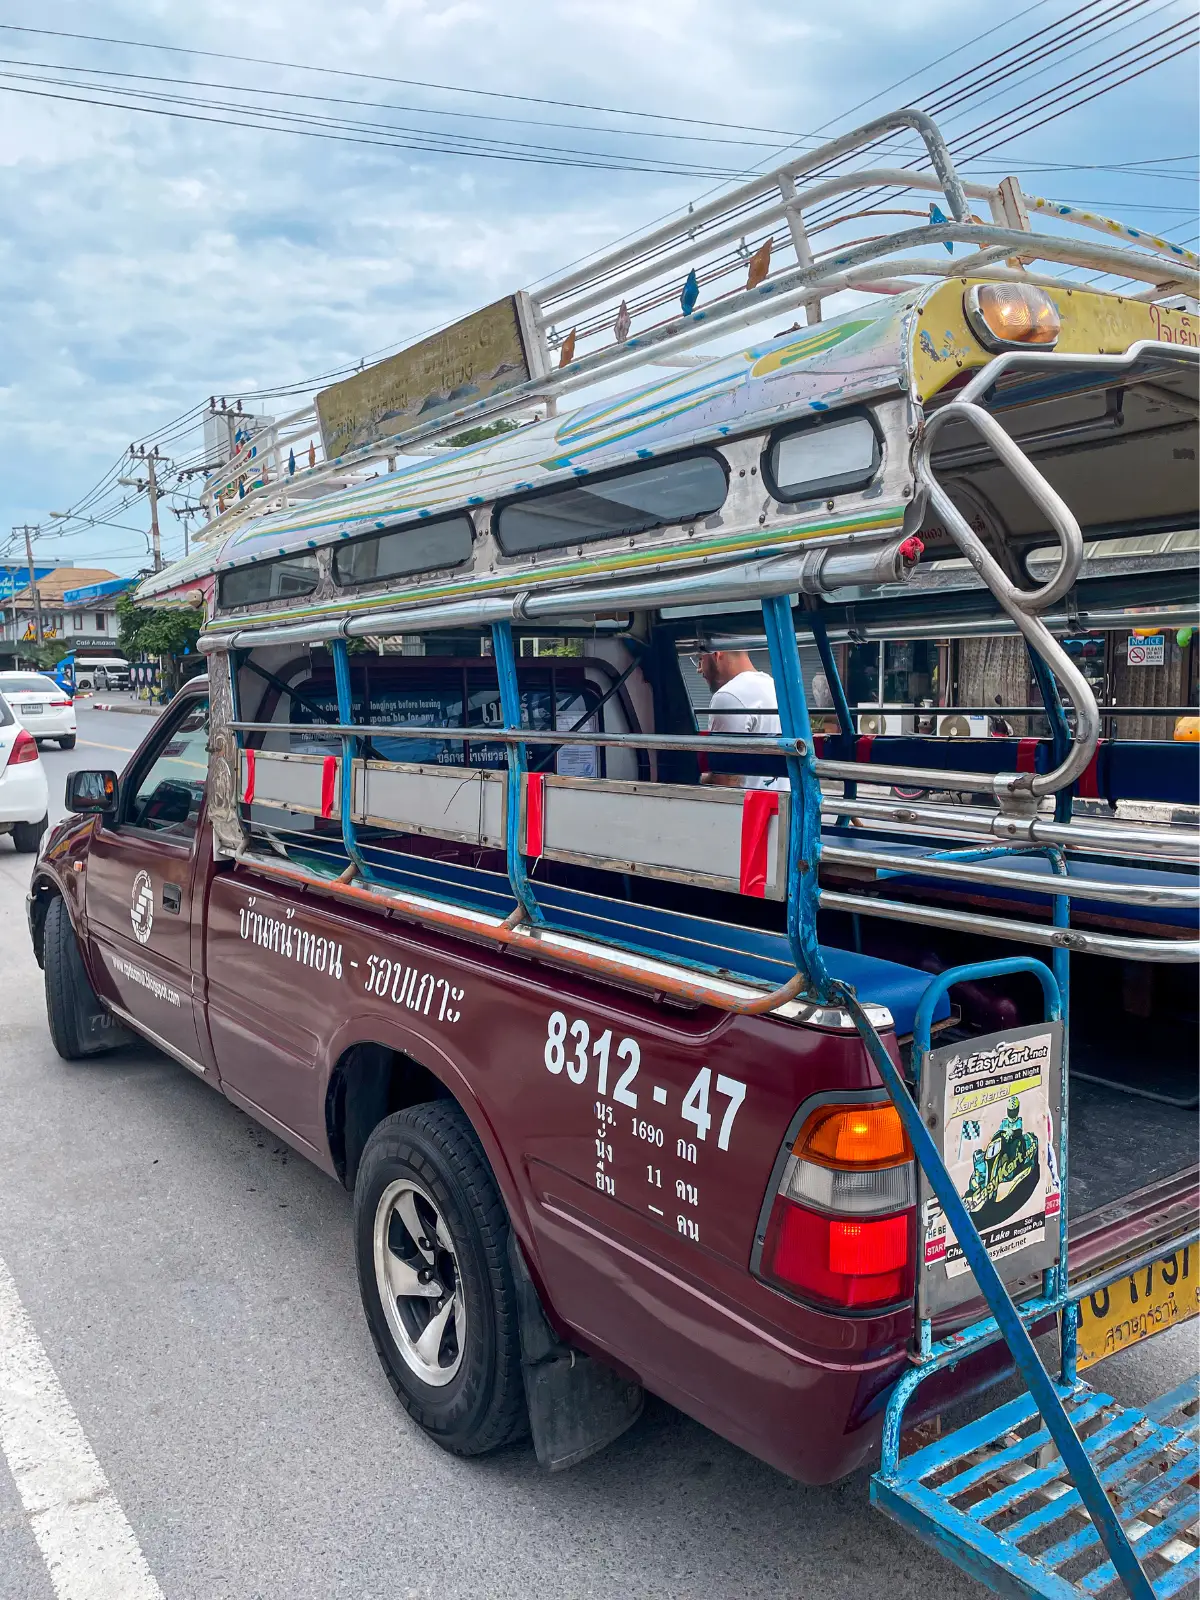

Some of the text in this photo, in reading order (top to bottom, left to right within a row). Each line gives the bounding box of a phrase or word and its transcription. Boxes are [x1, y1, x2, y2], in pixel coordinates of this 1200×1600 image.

[398, 700, 418, 709] before
[419, 699, 441, 710] leaving
[407, 712, 419, 721] for
[421, 713, 434, 722] any
[350, 960, 359, 968] -
[365, 954, 465, 1023] รอบเกาะ
[967, 1045, 1048, 1074] EasyKart.net
[544, 1011, 747, 1151] 8312 - 47
[955, 1083, 974, 1094] Open
[976, 1080, 984, 1088] 10
[1022, 1067, 1040, 1077] Night
[952, 1084, 1012, 1115] Kart Rental
[631, 1117, 664, 1147] 1690
[676, 1138, 697, 1164] กก
[646, 1165, 662, 1188] 11
[676, 1179, 699, 1206] คน
[676, 1214, 699, 1242] คน
[989, 1229, 1011, 1244] Lake
[1024, 1218, 1034, 1226] Soi
[1033, 1219, 1043, 1229] Pub
